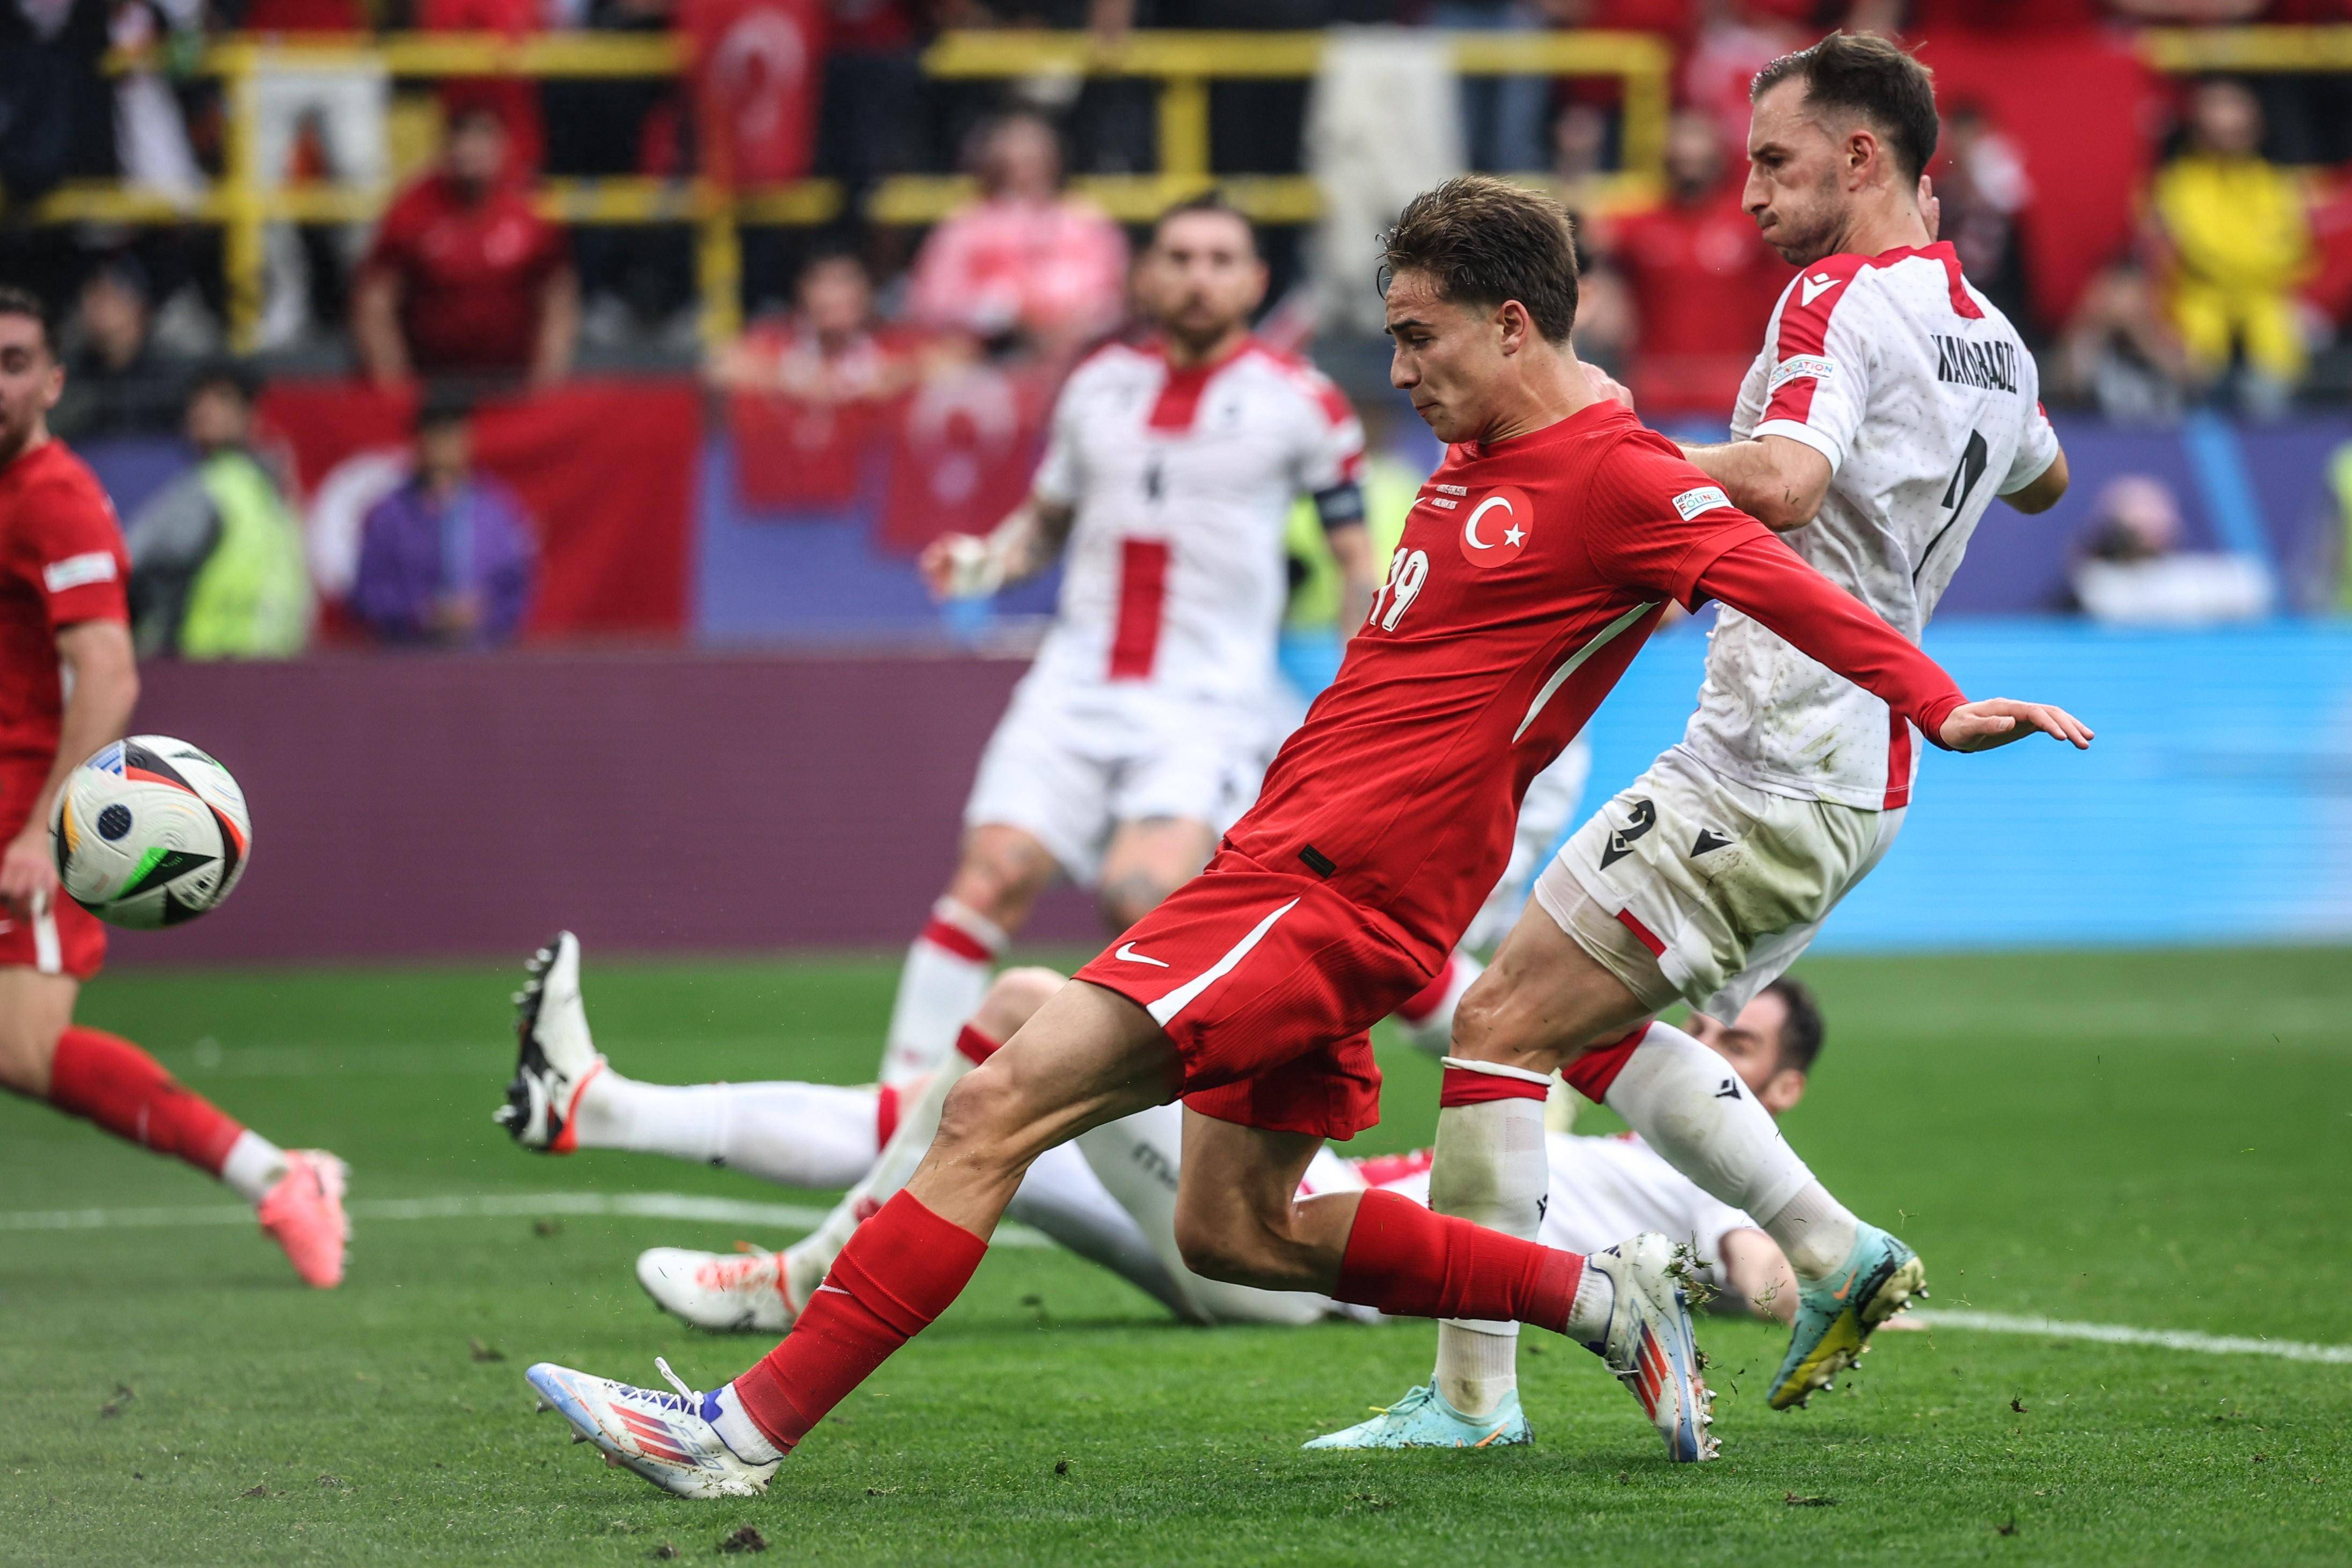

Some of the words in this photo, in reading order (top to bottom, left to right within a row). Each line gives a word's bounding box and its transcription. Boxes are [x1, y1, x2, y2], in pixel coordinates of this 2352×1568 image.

[1675, 493, 1692, 504] UEFA
[1679, 492, 1724, 513] FOUNDA
[1370, 547, 1429, 632] 19
